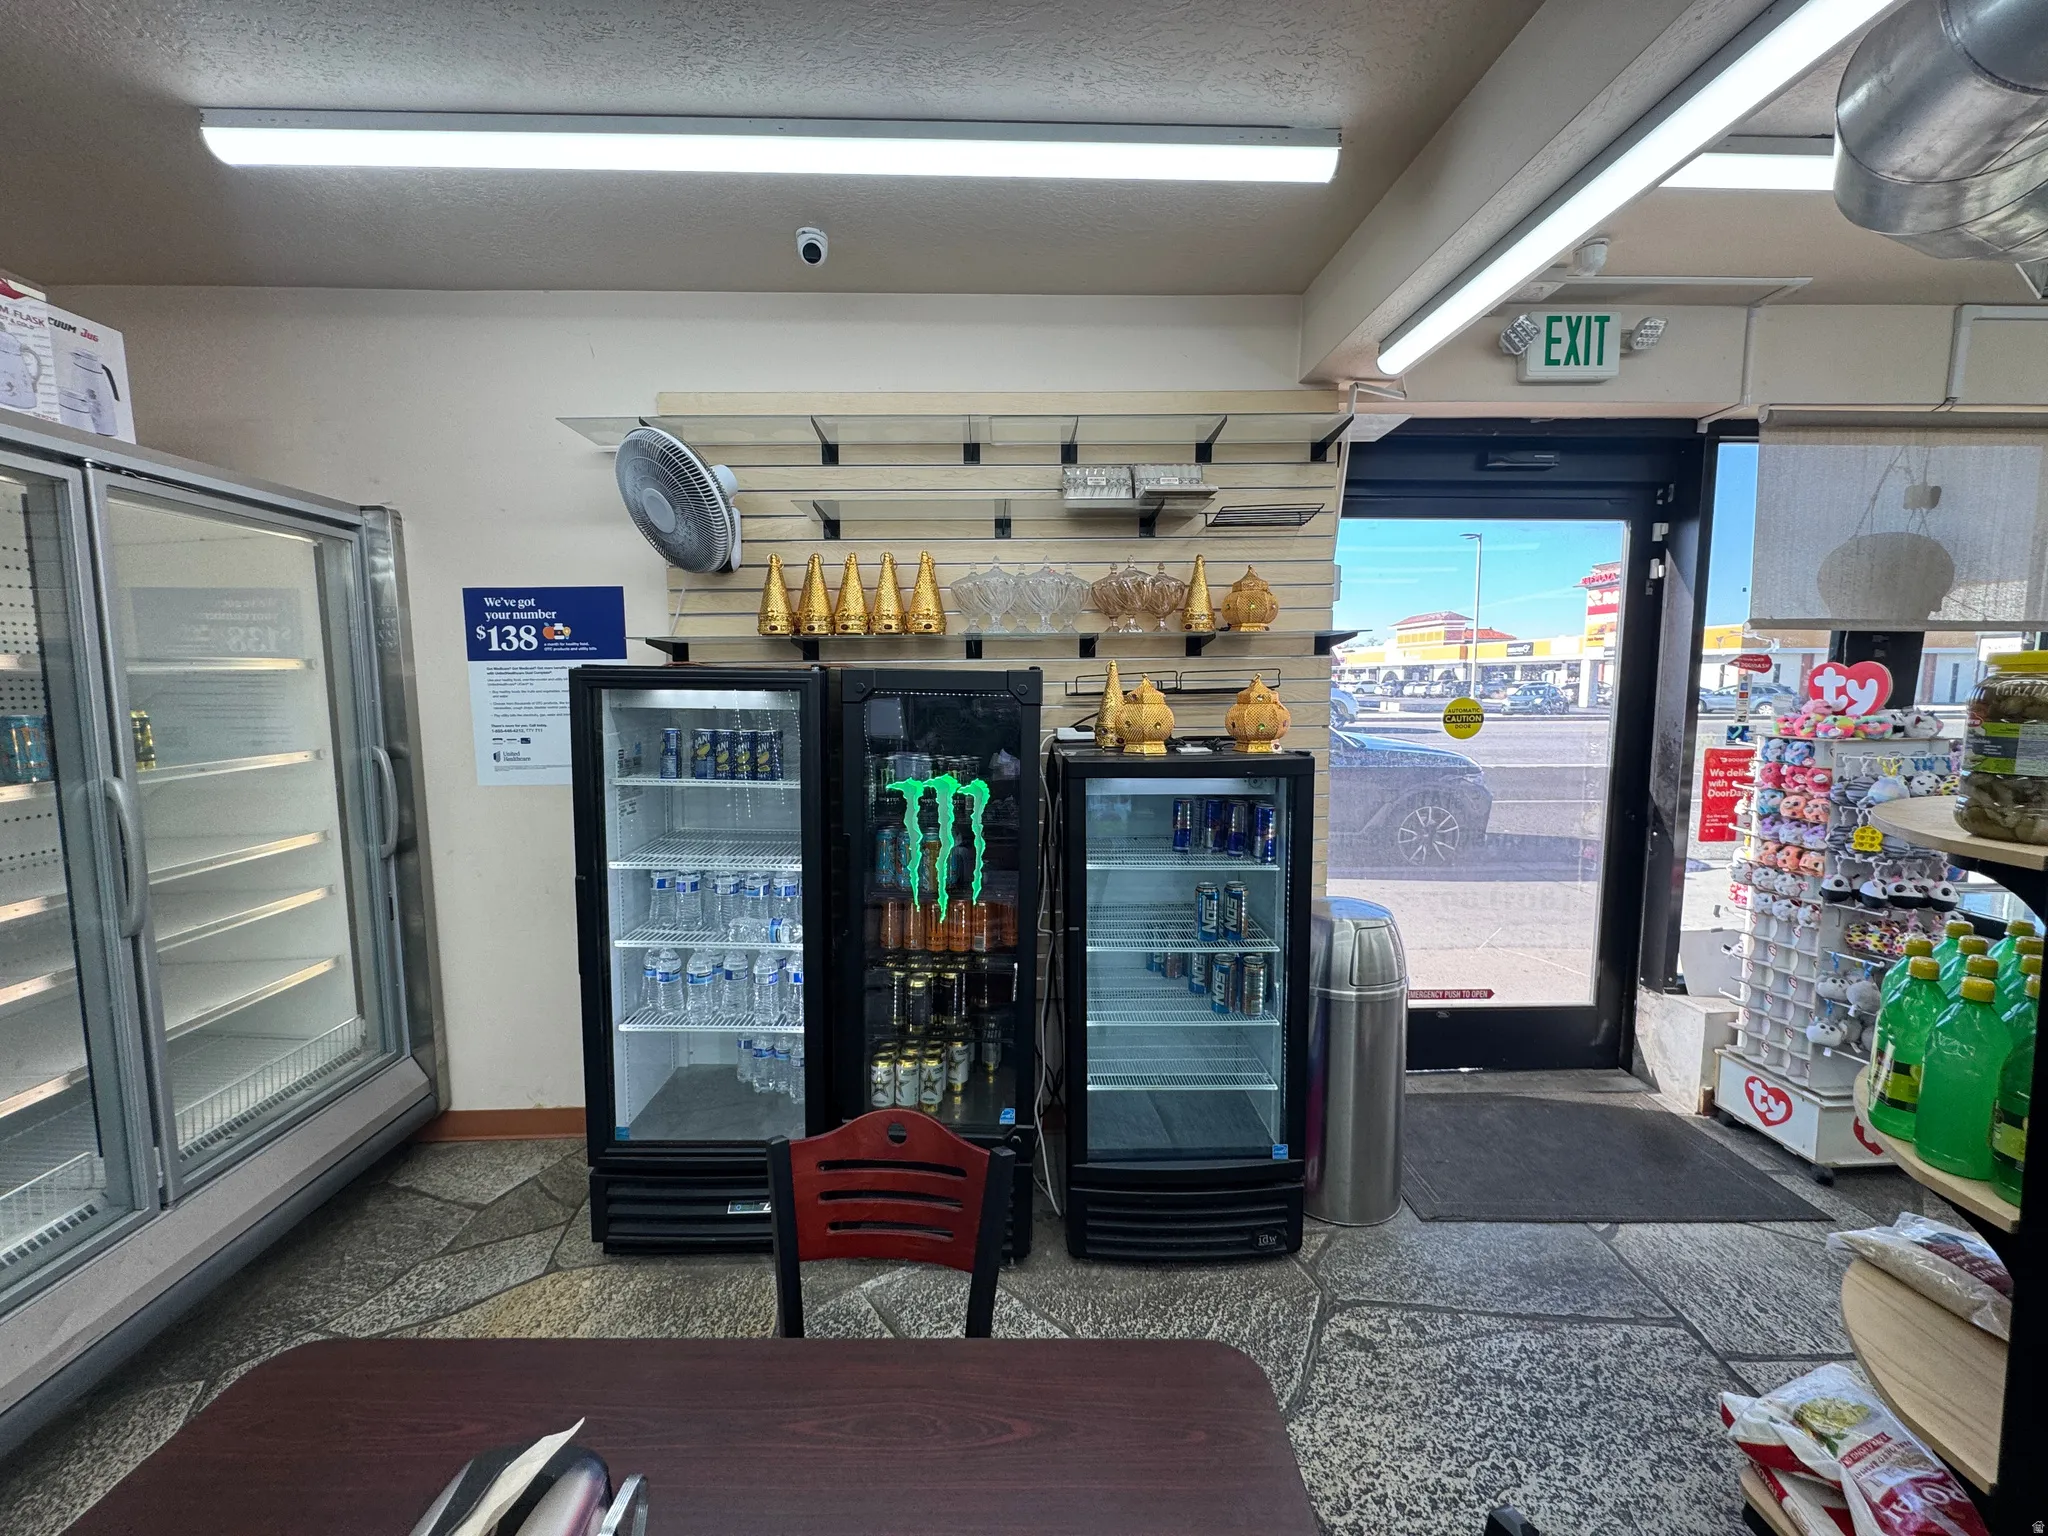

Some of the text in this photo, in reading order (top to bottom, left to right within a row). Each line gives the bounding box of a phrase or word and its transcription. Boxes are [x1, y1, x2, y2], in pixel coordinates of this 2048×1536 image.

[13, 310, 45, 327] FLASK
[1544, 315, 1611, 366] EXIT
[484, 597, 536, 609] We've got
[485, 609, 557, 622] your number
[475, 624, 539, 652] $138
[1813, 666, 1879, 716] ty
[1709, 769, 1724, 777] We
[1202, 895, 1217, 933] NOS
[1223, 893, 1238, 932] NOS
[1211, 965, 1226, 1005] NOS
[1408, 990, 1488, 999] EMERGENCY PUSH TO OPEN
[1748, 1080, 1787, 1122] ty
[1852, 1459, 1879, 1480] BASMAT
